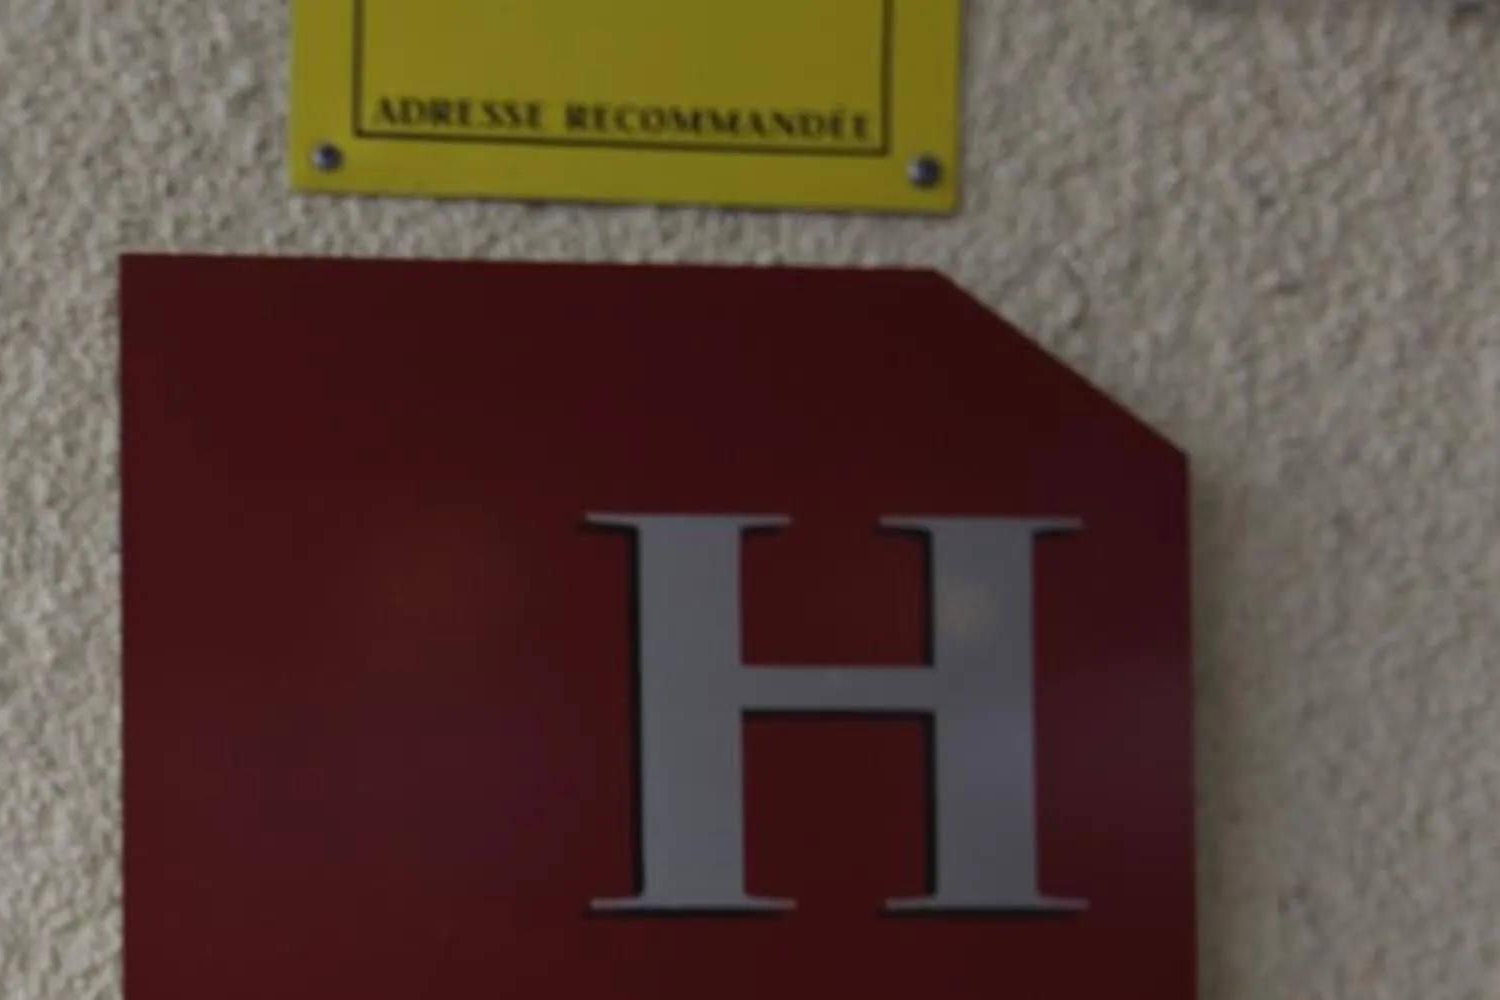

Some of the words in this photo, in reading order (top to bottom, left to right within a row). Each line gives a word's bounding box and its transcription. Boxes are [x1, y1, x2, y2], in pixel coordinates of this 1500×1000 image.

[374, 96, 545, 132] ADRESSE
[564, 103, 871, 142] RECOMMANDÉE
[580, 512, 1090, 914] H
